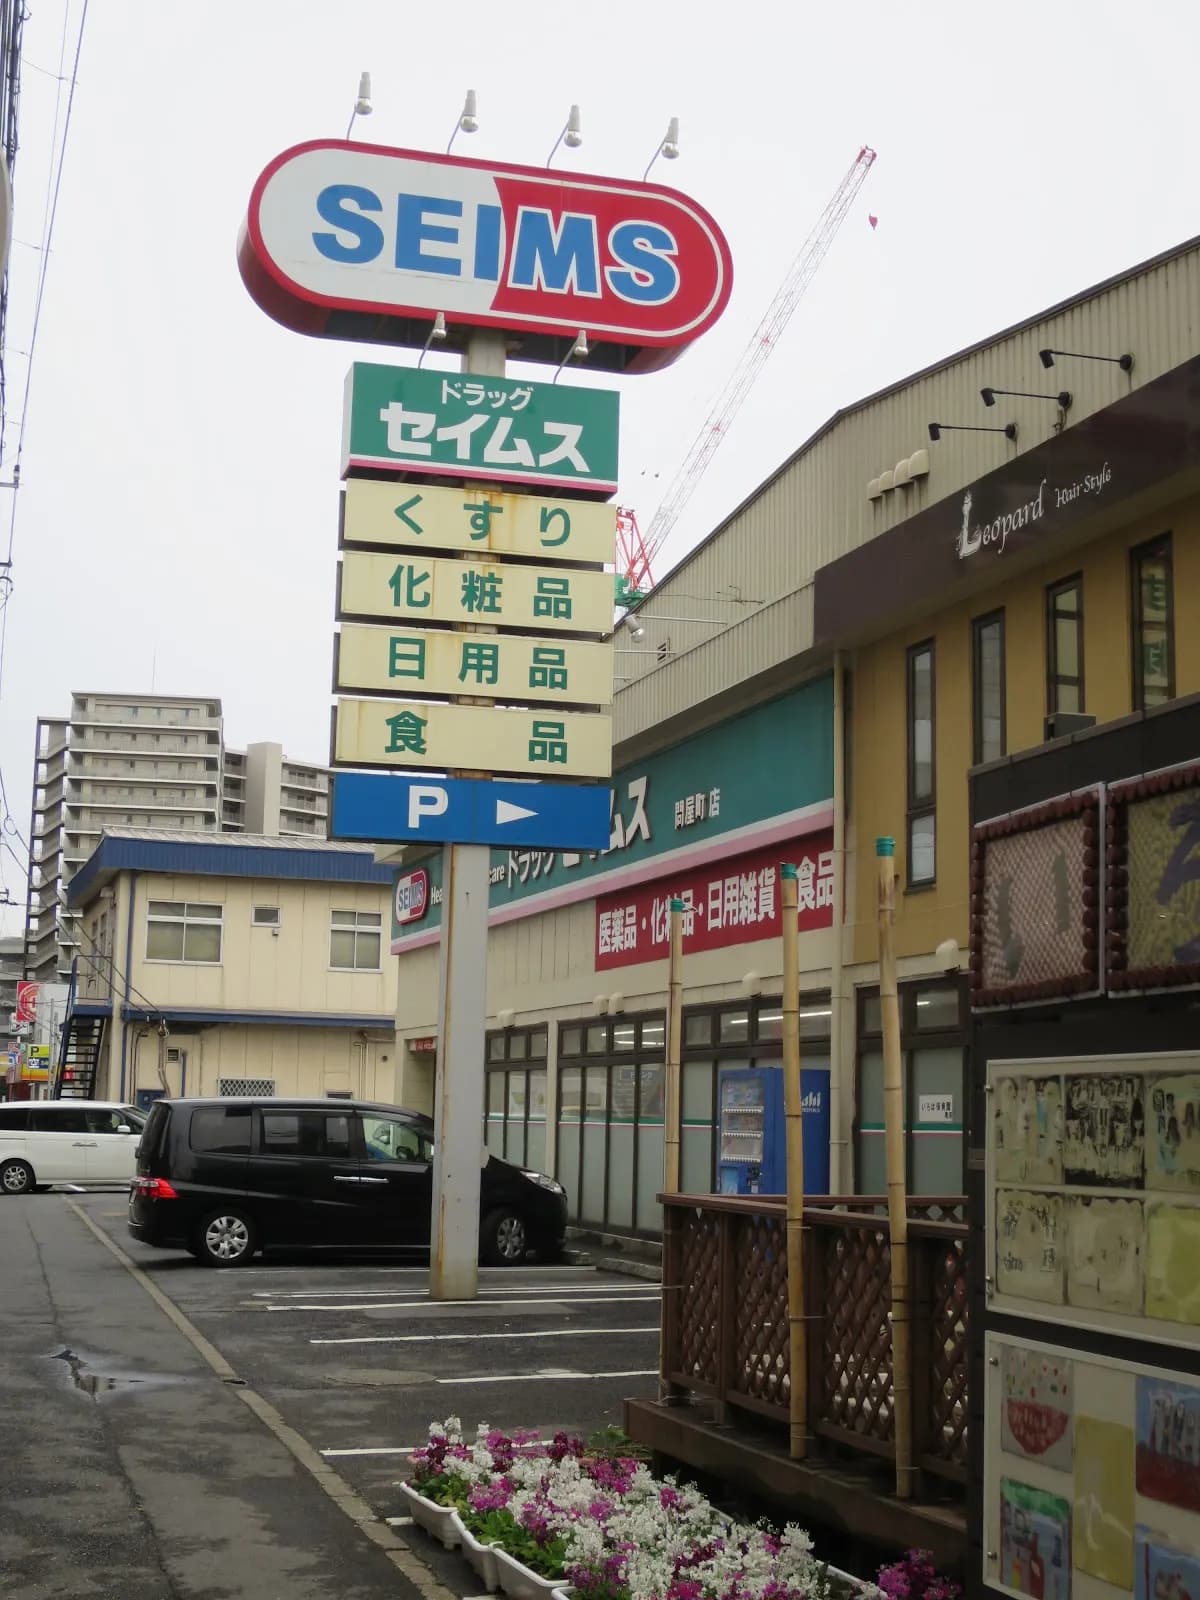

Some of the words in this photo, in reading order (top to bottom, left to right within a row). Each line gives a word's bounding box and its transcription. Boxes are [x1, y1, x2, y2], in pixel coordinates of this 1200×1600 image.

[311, 184, 680, 306] SEIMS
[441, 379, 534, 411] ドラッグ
[379, 401, 591, 473] セイムス
[394, 494, 571, 547] くすり
[955, 478, 1047, 559] Leopard
[1054, 482, 1083, 508] Hair
[388, 564, 572, 619] 化粧品
[388, 636, 568, 690] 日用品
[384, 711, 568, 763] 食品
[408, 785, 449, 828] P
[398, 879, 424, 912] SEIMS
[30, 1046, 40, 1057] P
